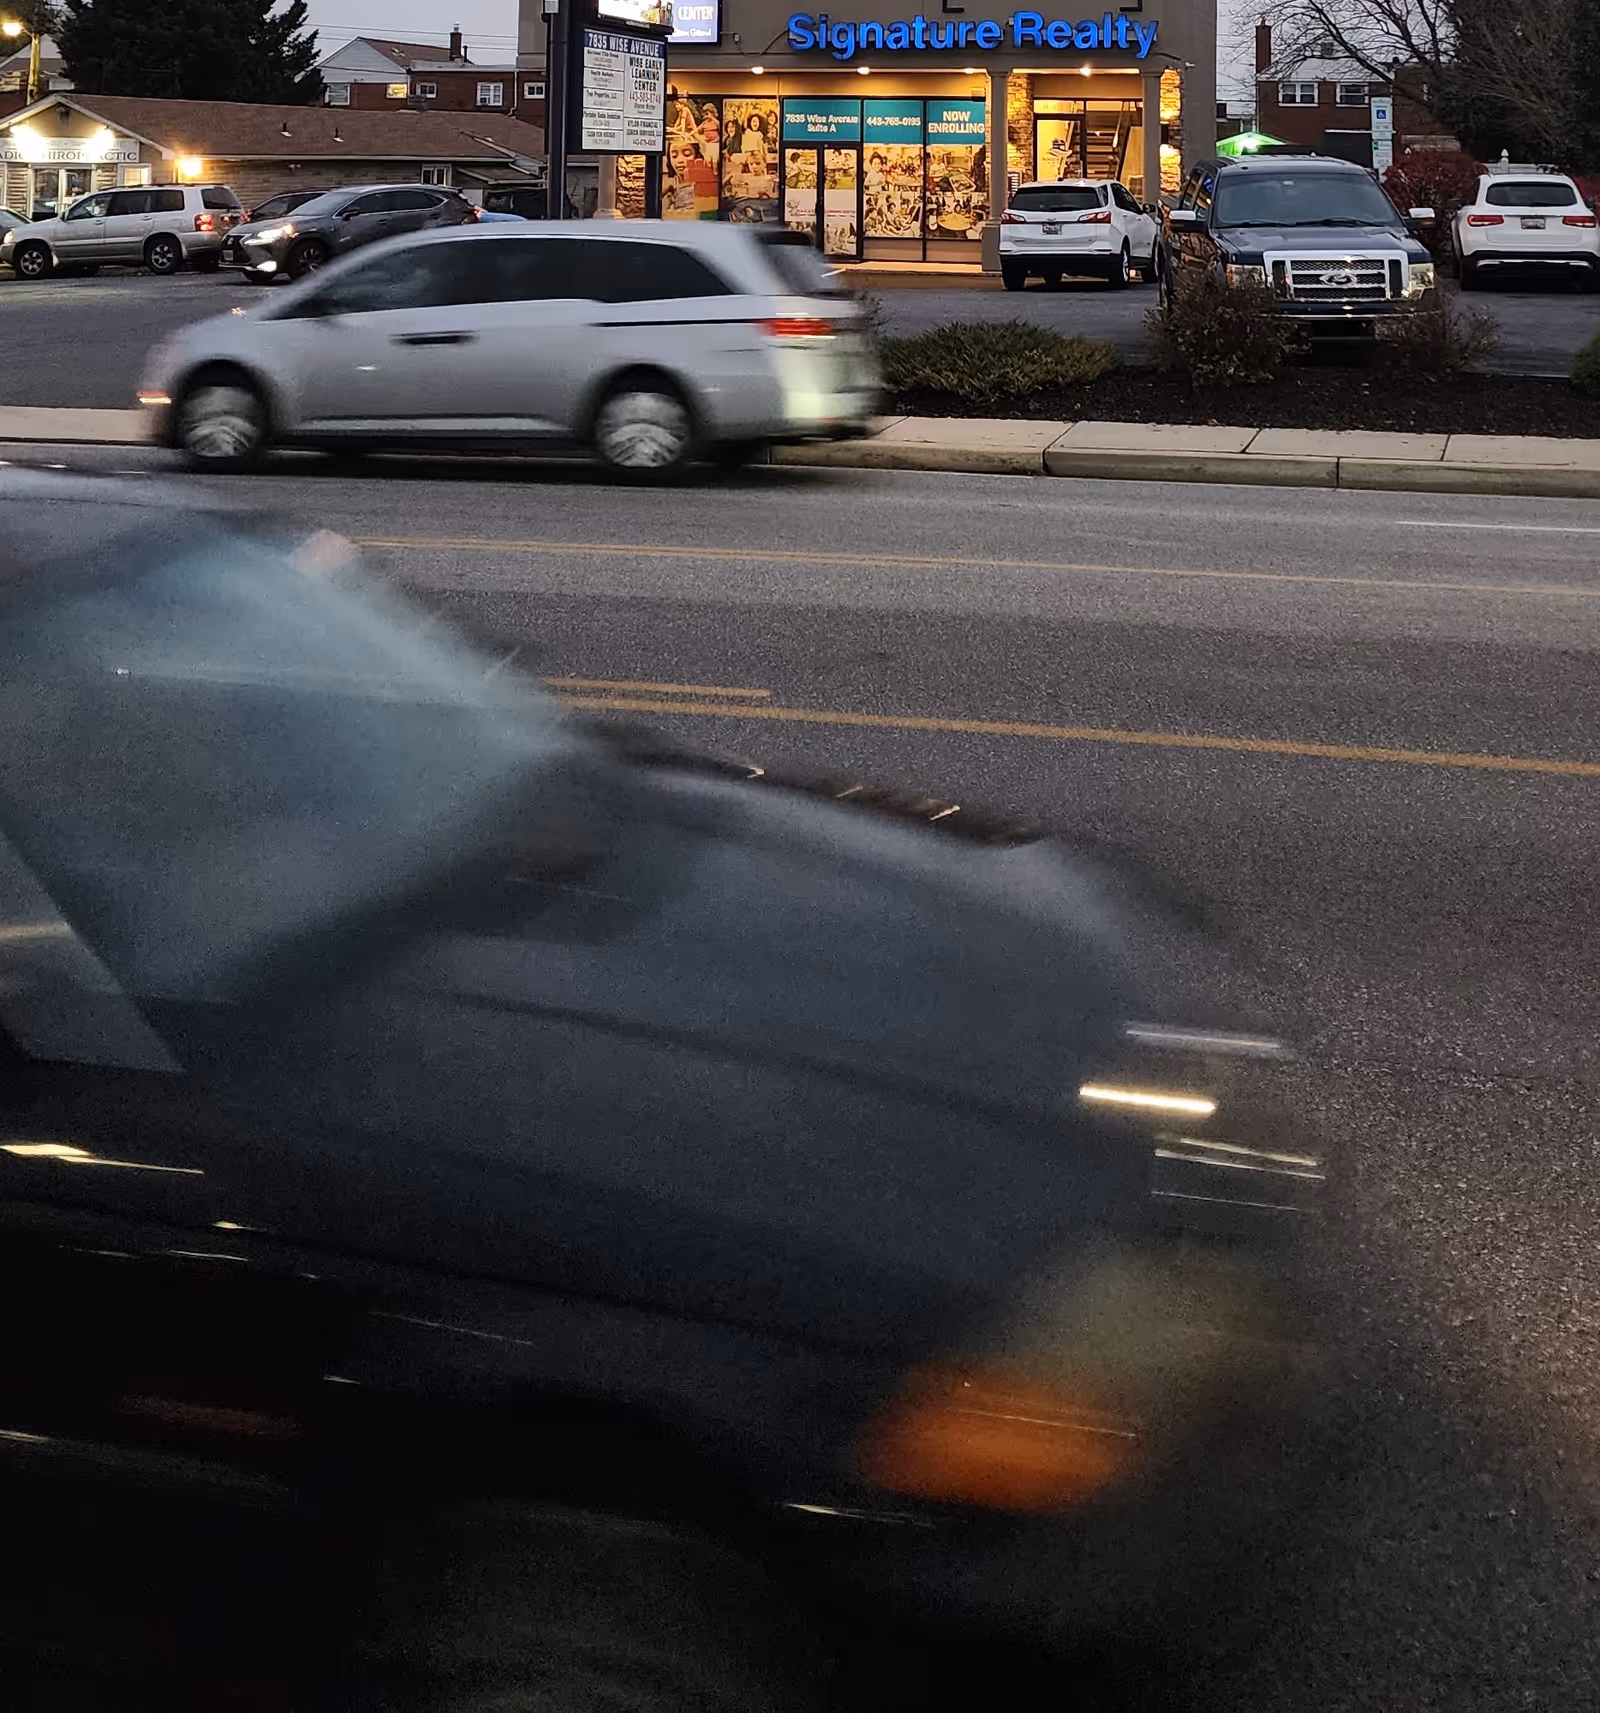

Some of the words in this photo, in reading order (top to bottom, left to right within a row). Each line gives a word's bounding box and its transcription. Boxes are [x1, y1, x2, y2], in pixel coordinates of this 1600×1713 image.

[678, 5, 713, 21] CENTER
[786, 11, 1002, 61] Signature
[1011, 10, 1158, 60] Realty
[588, 33, 607, 49] 7835
[609, 36, 629, 52] WISE
[630, 40, 659, 57] AVENUE
[629, 56, 643, 68] WISE
[645, 59, 662, 71] EARLY
[631, 68, 660, 81] LEARNING
[634, 80, 657, 92] CENTER
[785, 113, 805, 123] 7835
[806, 114, 827, 123] Wise
[828, 114, 858, 124] Avenue
[942, 110, 971, 122] NOW
[807, 123, 828, 132] Suite
[829, 123, 837, 133] A
[928, 122, 985, 134] ENROLLING
